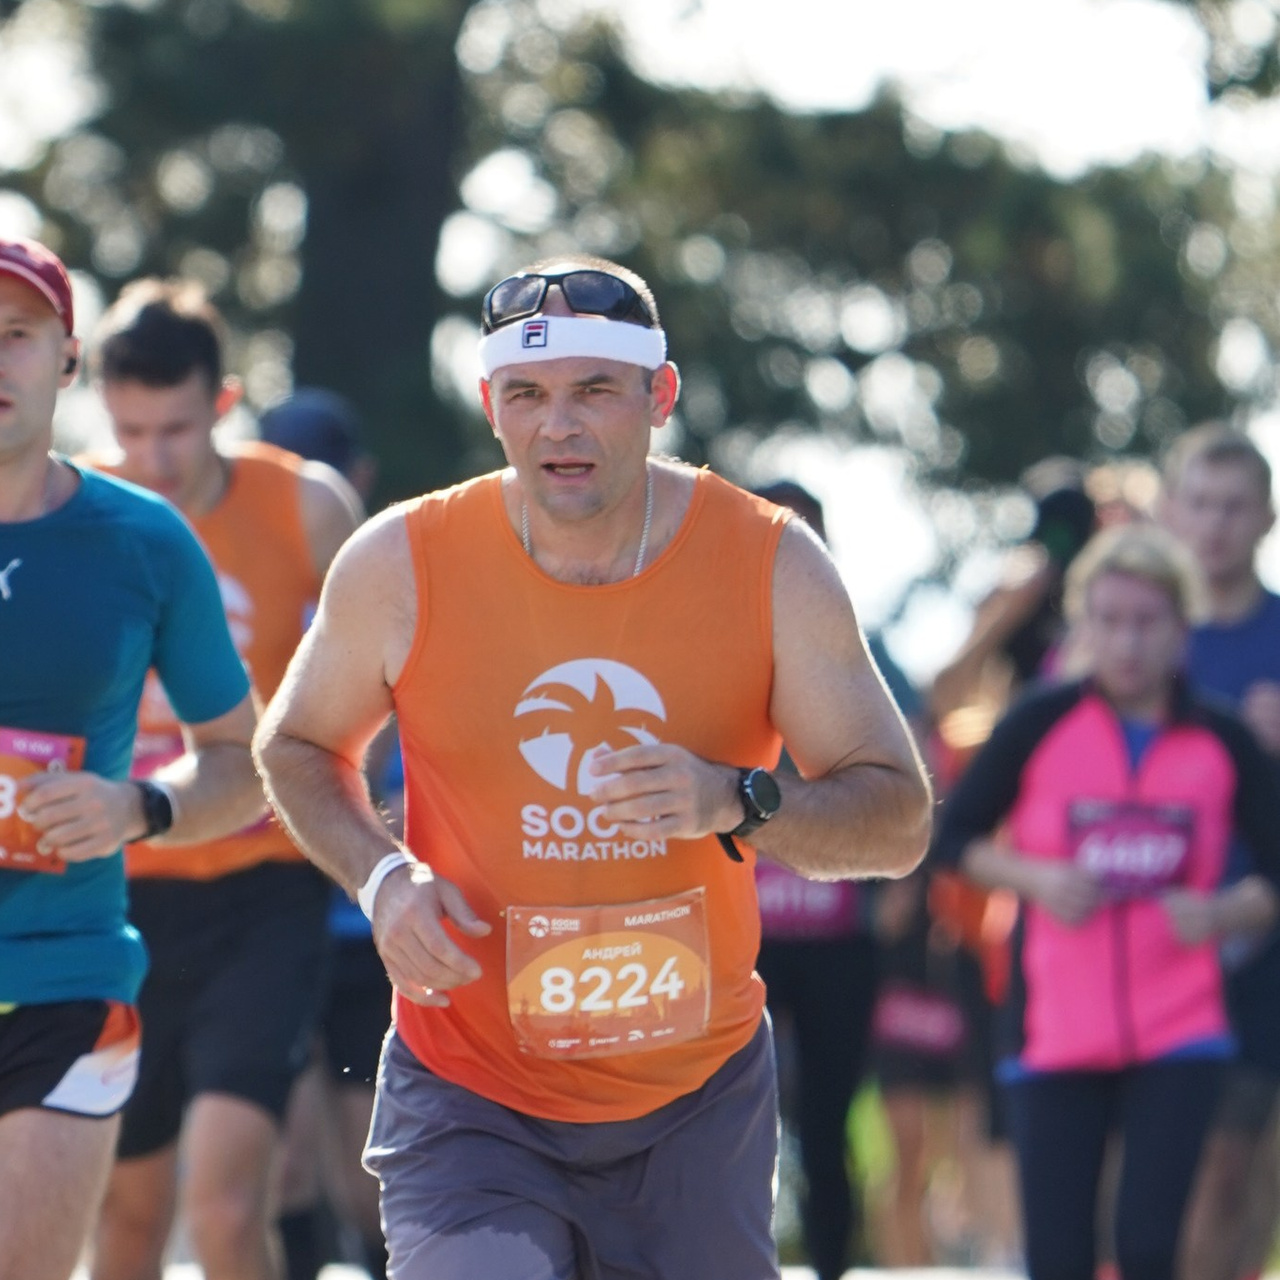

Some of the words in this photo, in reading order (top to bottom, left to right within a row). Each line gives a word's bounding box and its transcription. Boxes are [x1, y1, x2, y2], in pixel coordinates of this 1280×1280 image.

[521, 804, 624, 838] SOC
[522, 838, 667, 861] MARATHON
[624, 905, 691, 927] MARATHON
[581, 942, 643, 960] АНДРЕЙ
[540, 956, 685, 1013] 8224
